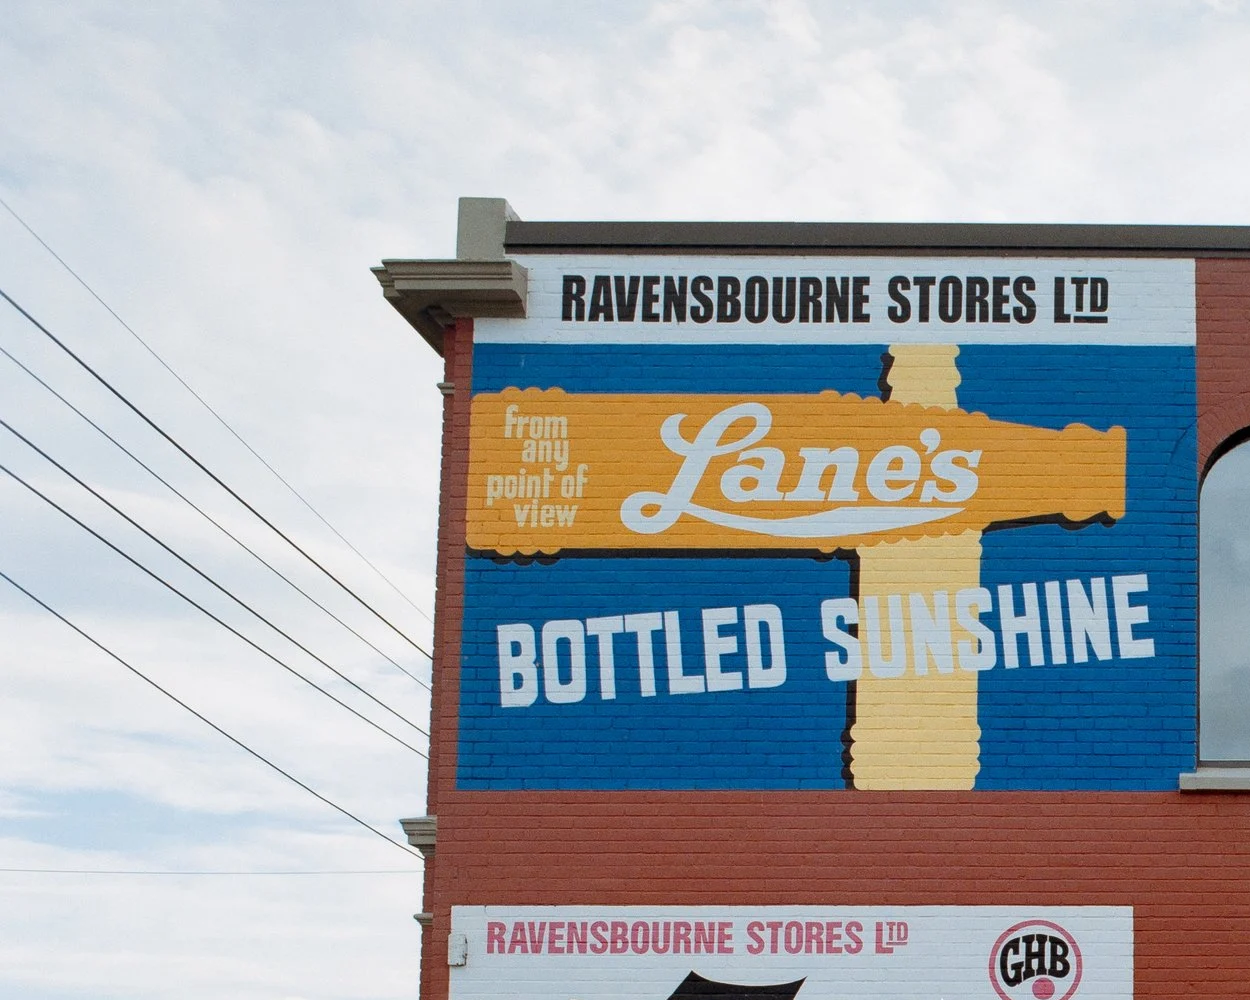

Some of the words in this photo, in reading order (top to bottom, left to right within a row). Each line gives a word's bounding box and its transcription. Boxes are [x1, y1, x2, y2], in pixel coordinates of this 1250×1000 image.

[561, 274, 871, 324] RAVENSBOURNE
[887, 274, 1037, 324] STORES
[503, 404, 568, 438] from
[522, 439, 569, 470] any
[620, 402, 983, 538] Lane's
[487, 468, 555, 506] point
[560, 463, 589, 499] of
[513, 500, 578, 528] view
[496, 603, 788, 708] BOTTLED
[820, 573, 1156, 683] SUNSHINE
[486, 920, 734, 955] RAVENSBOURNE
[745, 920, 863, 955] STORES
[999, 933, 1071, 987] GHB
